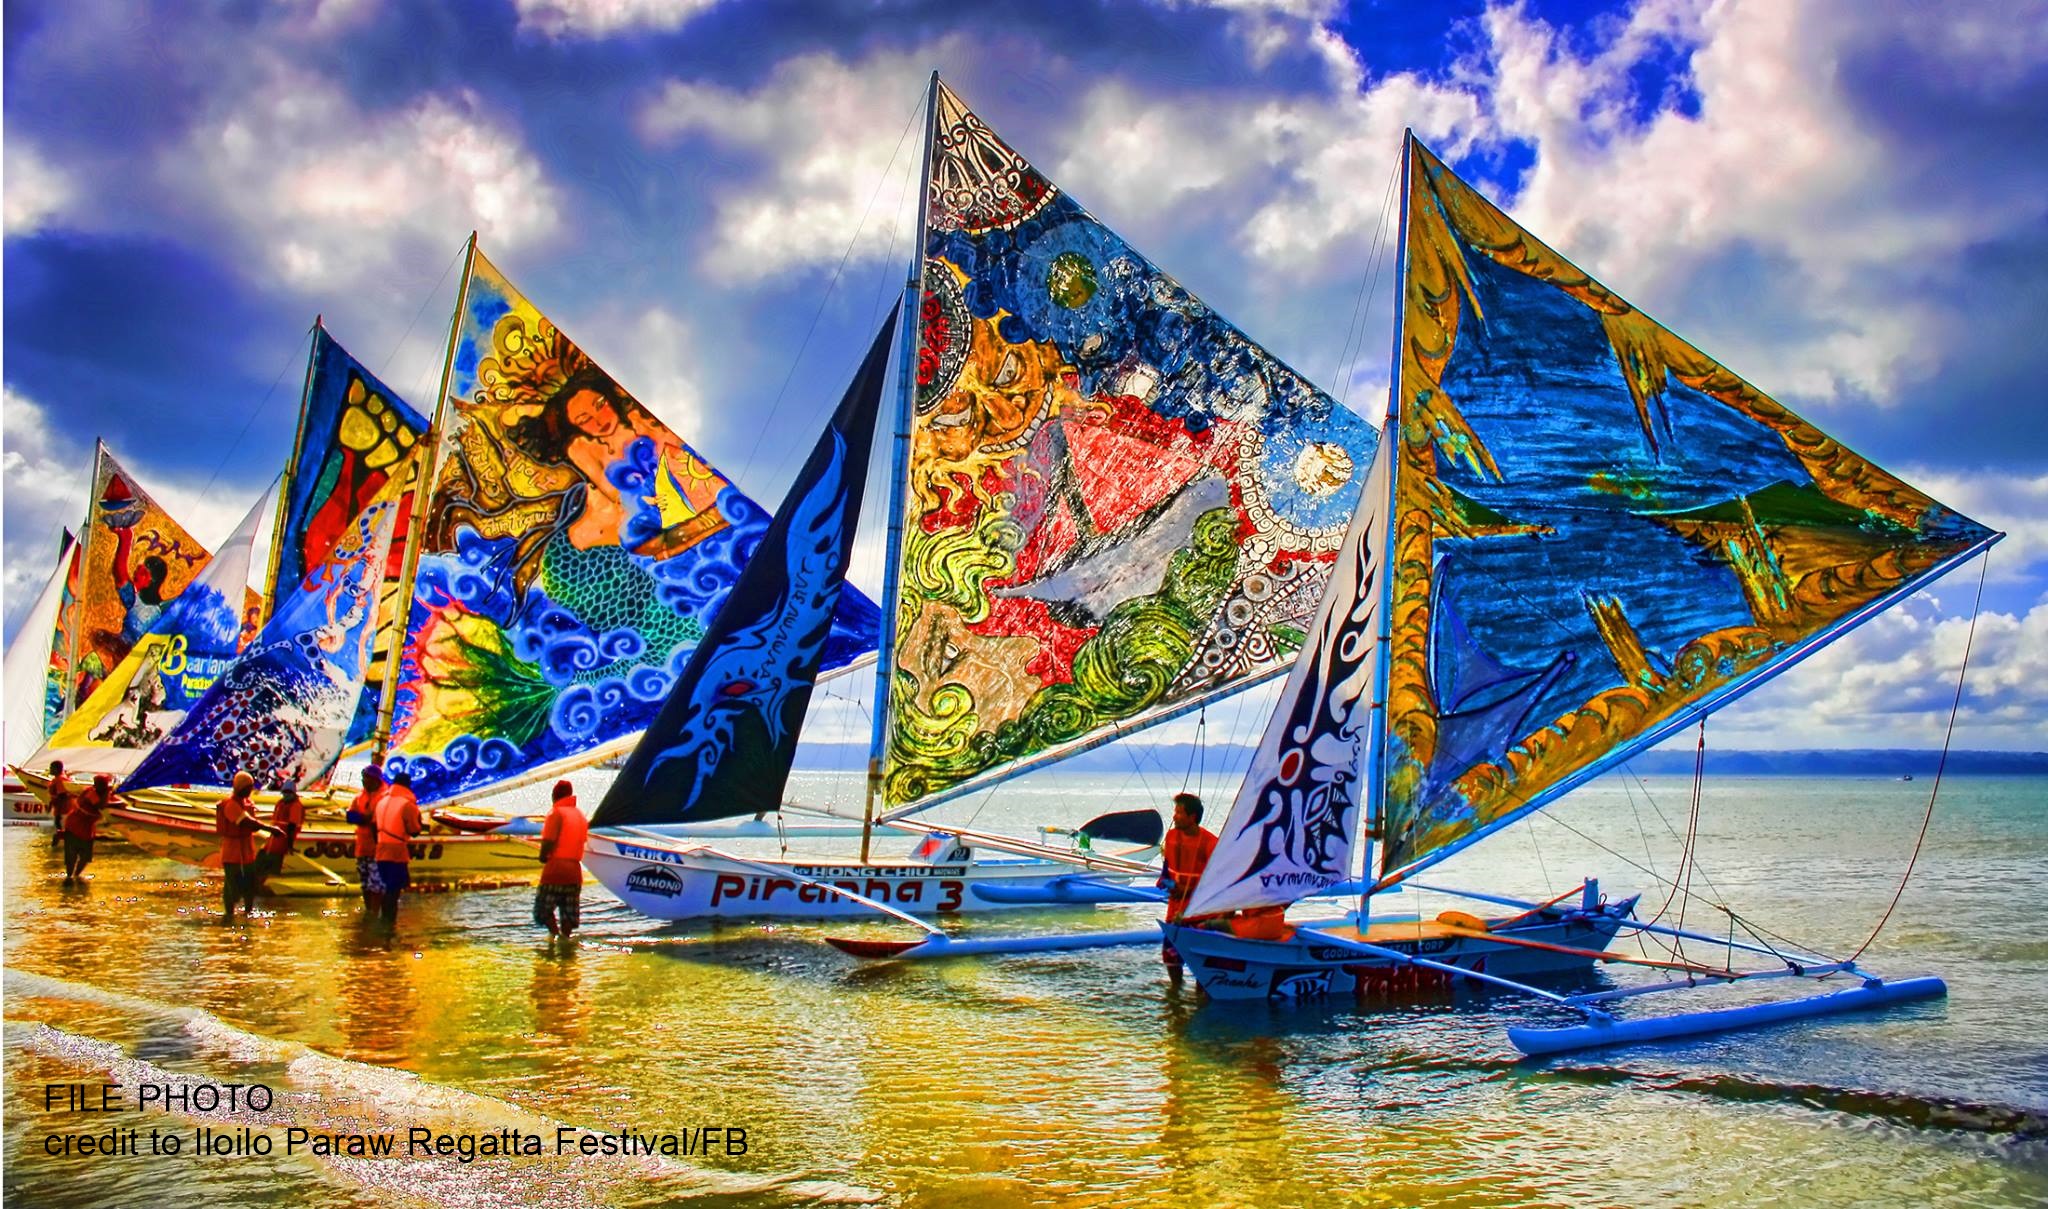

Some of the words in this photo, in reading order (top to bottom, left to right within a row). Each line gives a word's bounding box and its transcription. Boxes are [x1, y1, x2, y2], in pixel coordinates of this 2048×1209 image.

[811, 867, 876, 877] HONG
[880, 867, 931, 877] CHIU
[629, 874, 682, 891] DIAMOND
[937, 881, 964, 911] 3
